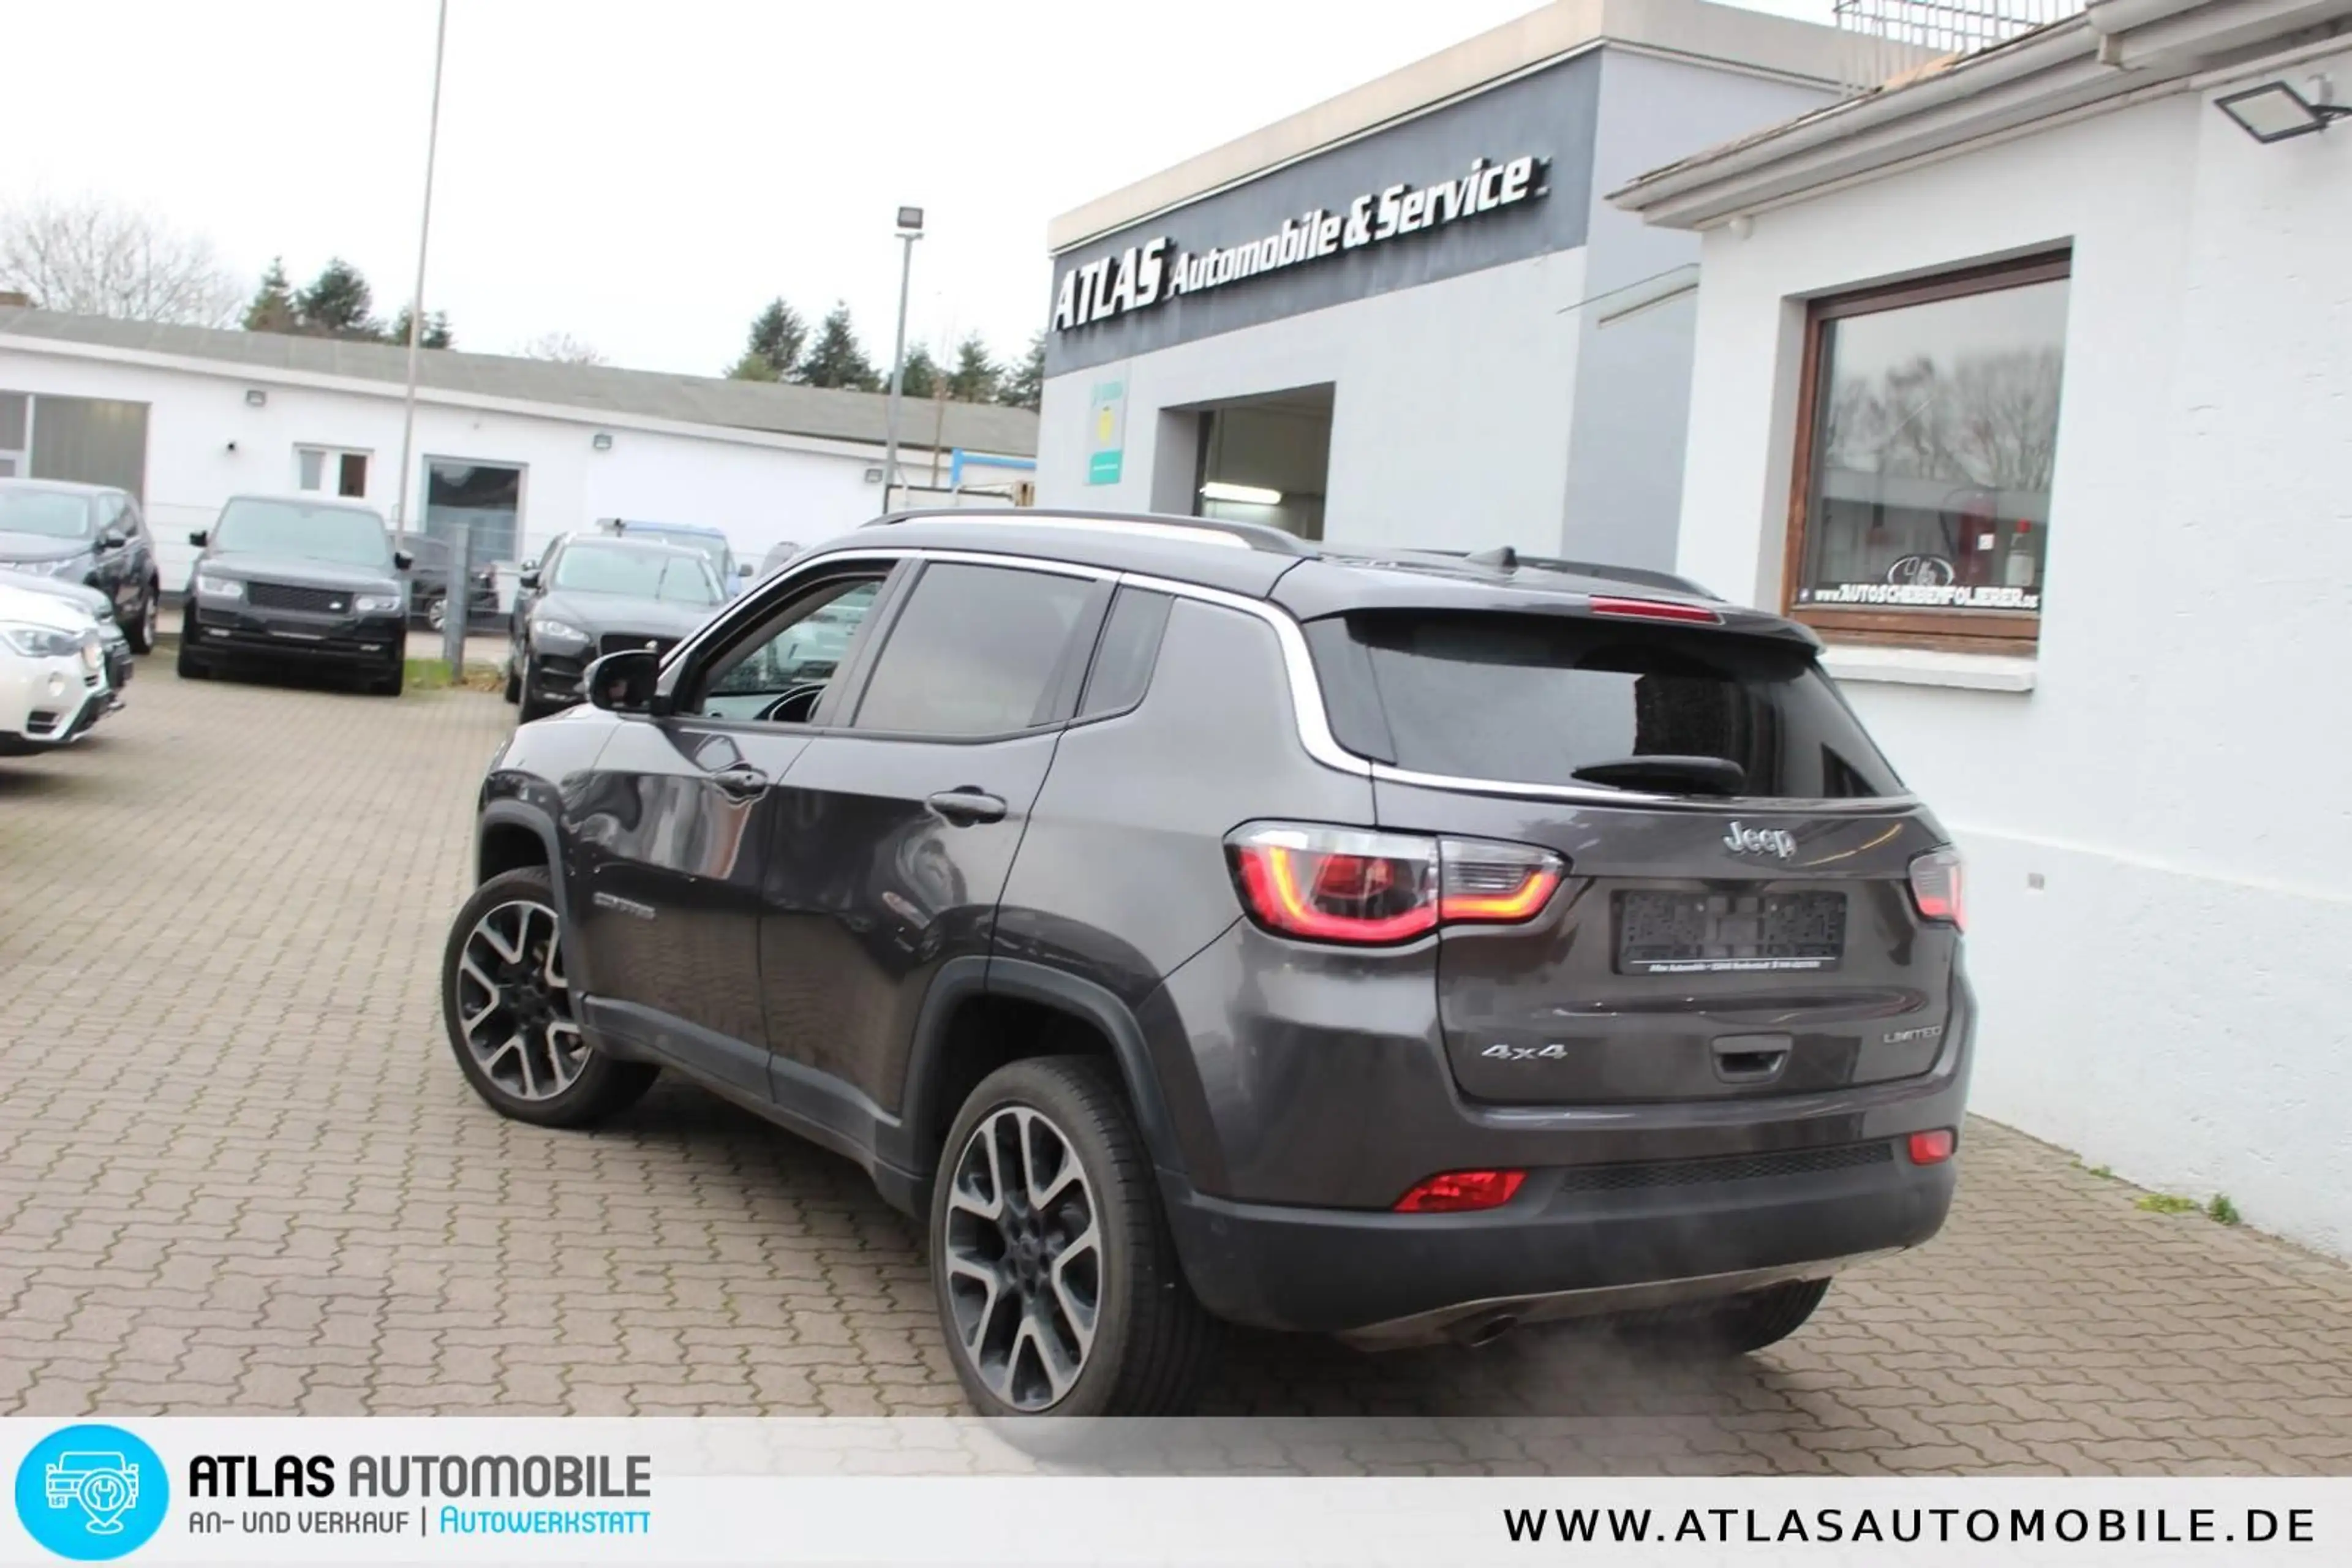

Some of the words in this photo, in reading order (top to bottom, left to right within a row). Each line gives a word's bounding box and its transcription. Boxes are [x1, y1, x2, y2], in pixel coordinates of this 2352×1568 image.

[1052, 236, 1166, 333] ATLAS
[1164, 208, 1341, 299] Automobile
[1342, 194, 1373, 249] &
[1373, 156, 1532, 241] Service
[1722, 821, 1797, 859] Jeep
[1481, 1044, 1569, 1061] 4x4
